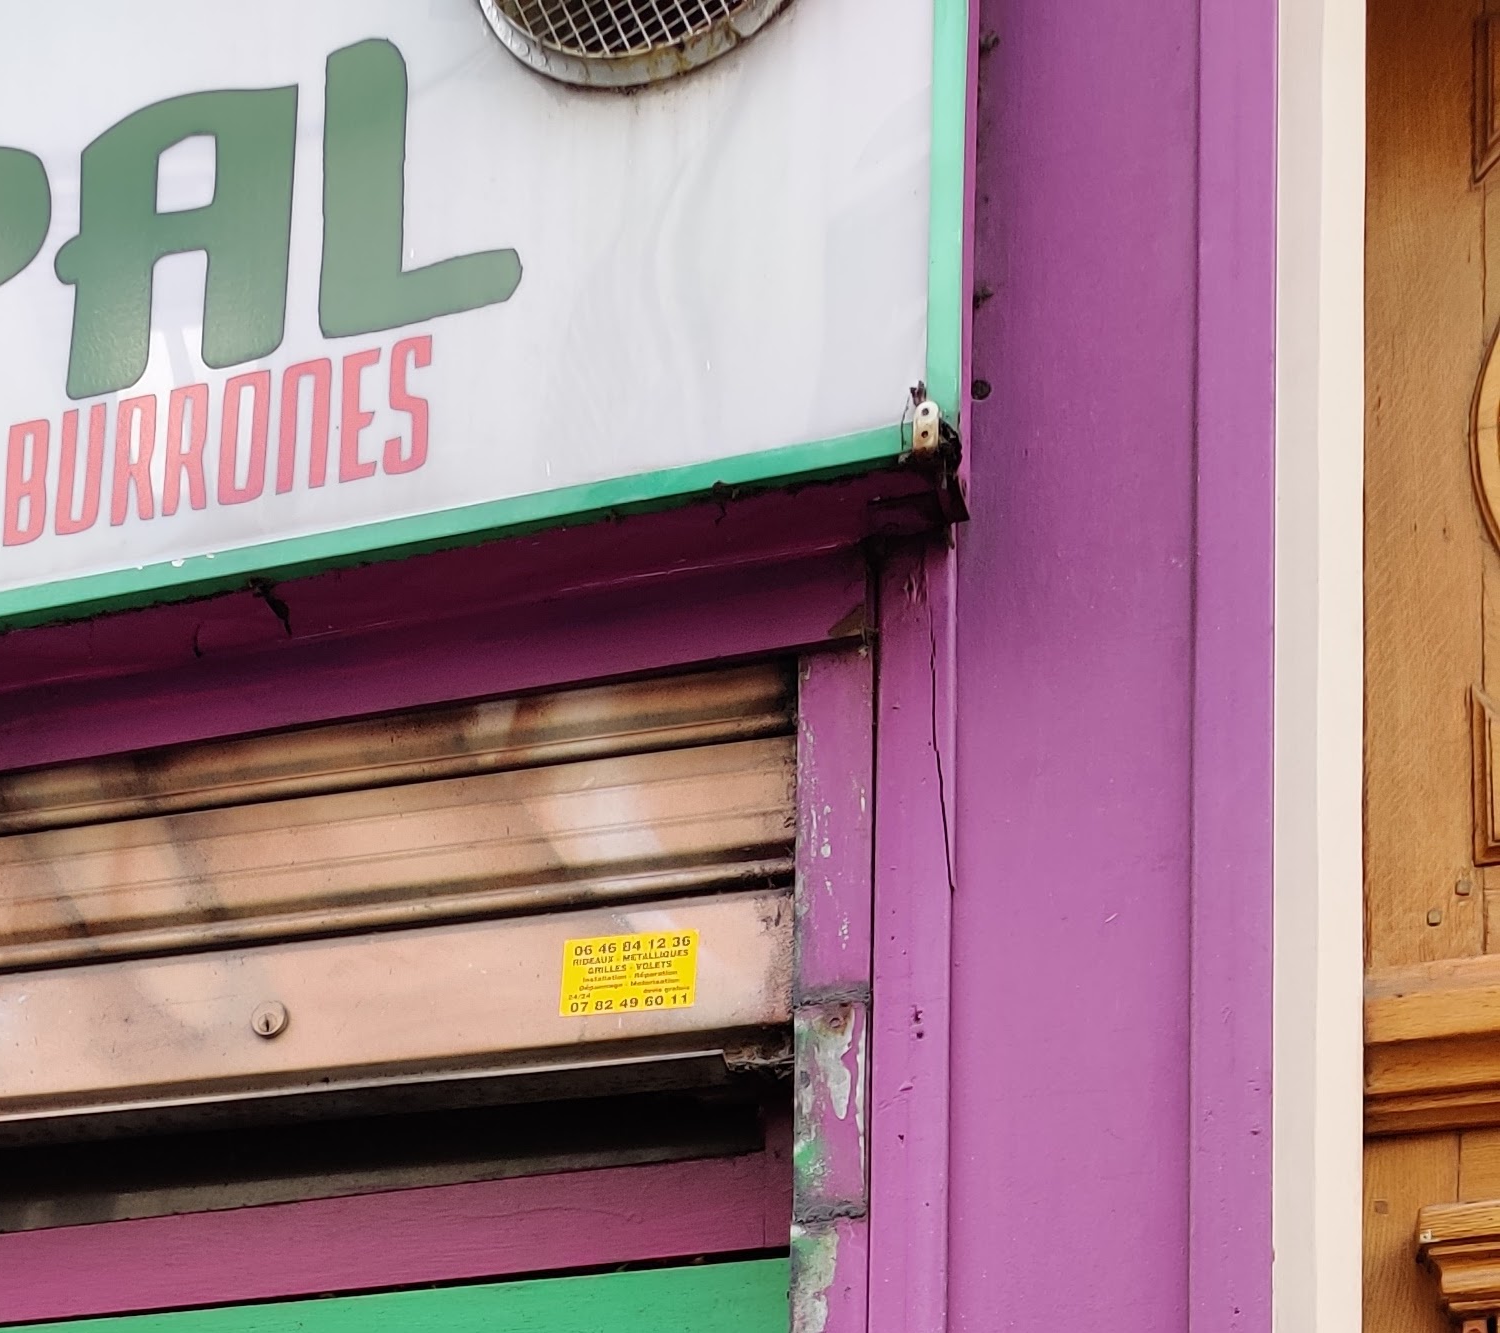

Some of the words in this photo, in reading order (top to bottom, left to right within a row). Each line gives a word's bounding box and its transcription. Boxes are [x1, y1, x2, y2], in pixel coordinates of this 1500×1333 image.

[2, 334, 433, 548] BURRONES
[574, 945, 593, 956] 06
[598, 943, 617, 954] 46
[649, 938, 666, 949] 12
[636, 960, 672, 971] VOLETS
[570, 1002, 589, 1013] 07
[619, 997, 639, 1008] 49
[670, 993, 688, 1004] 11
